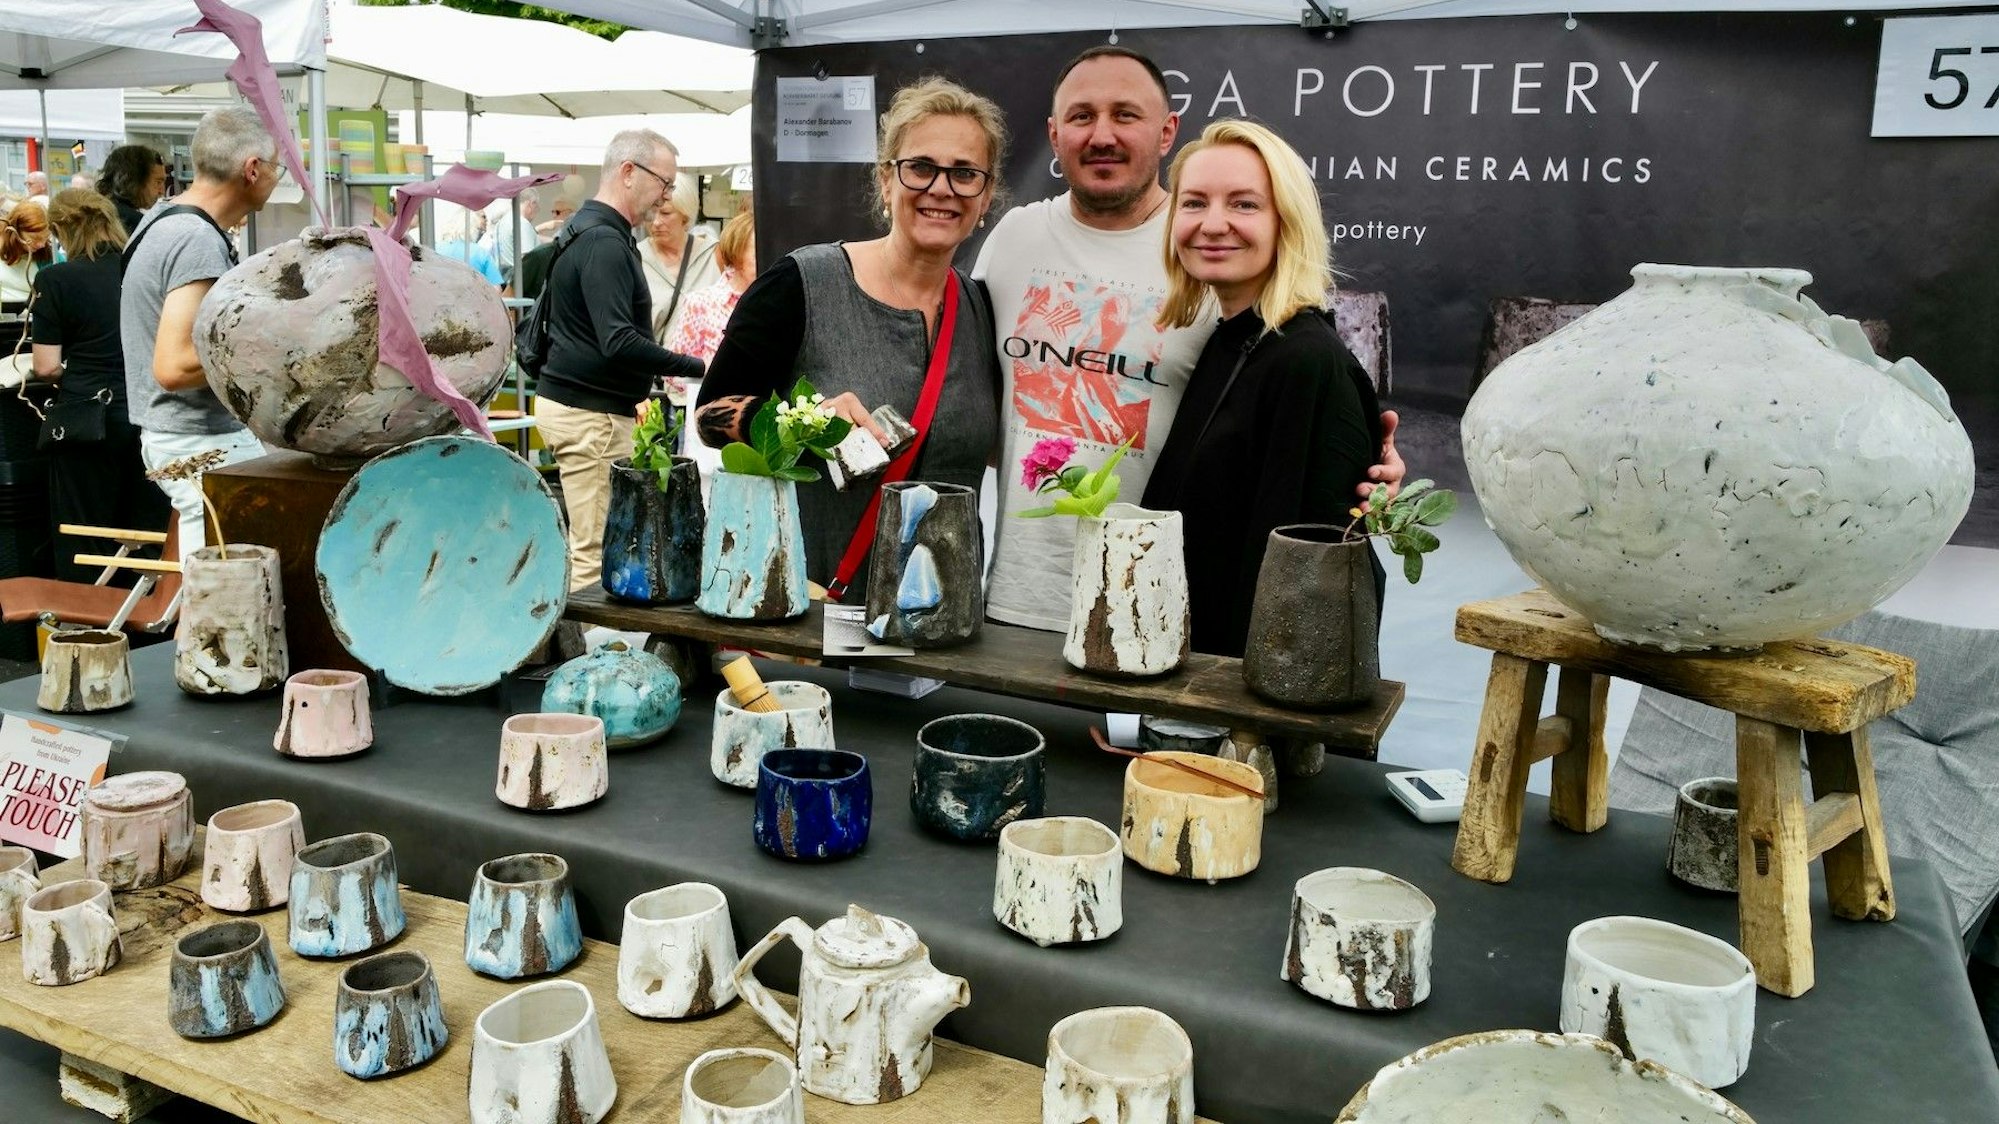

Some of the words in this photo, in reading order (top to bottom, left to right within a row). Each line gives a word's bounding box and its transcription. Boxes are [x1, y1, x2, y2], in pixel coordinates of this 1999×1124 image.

[1160, 69, 1248, 117] GA
[1294, 61, 1660, 117] POTTERY
[1924, 47, 1999, 109] 57
[849, 87, 865, 105] 57
[794, 129, 829, 138] Dormagen
[818, 118, 852, 126] Barabanov
[1305, 156, 1397, 180] NIAN
[1425, 156, 1651, 183] CERAMICS
[1333, 221, 1427, 246] pottery
[1032, 268, 1067, 276] FIRST
[1100, 278, 1135, 289] LAST
[1147, 286, 1166, 294] OU
[1003, 336, 1169, 387] O'NEILL
[1076, 441, 1106, 453] ANTA
[31, 735, 63, 750] Handcrafted
[62, 744, 81, 758] pottery
[37, 749, 50, 759] from
[50, 753, 70, 765] Ukraine
[0, 761, 85, 807] PLEASE
[0, 794, 79, 840] TOUCH
